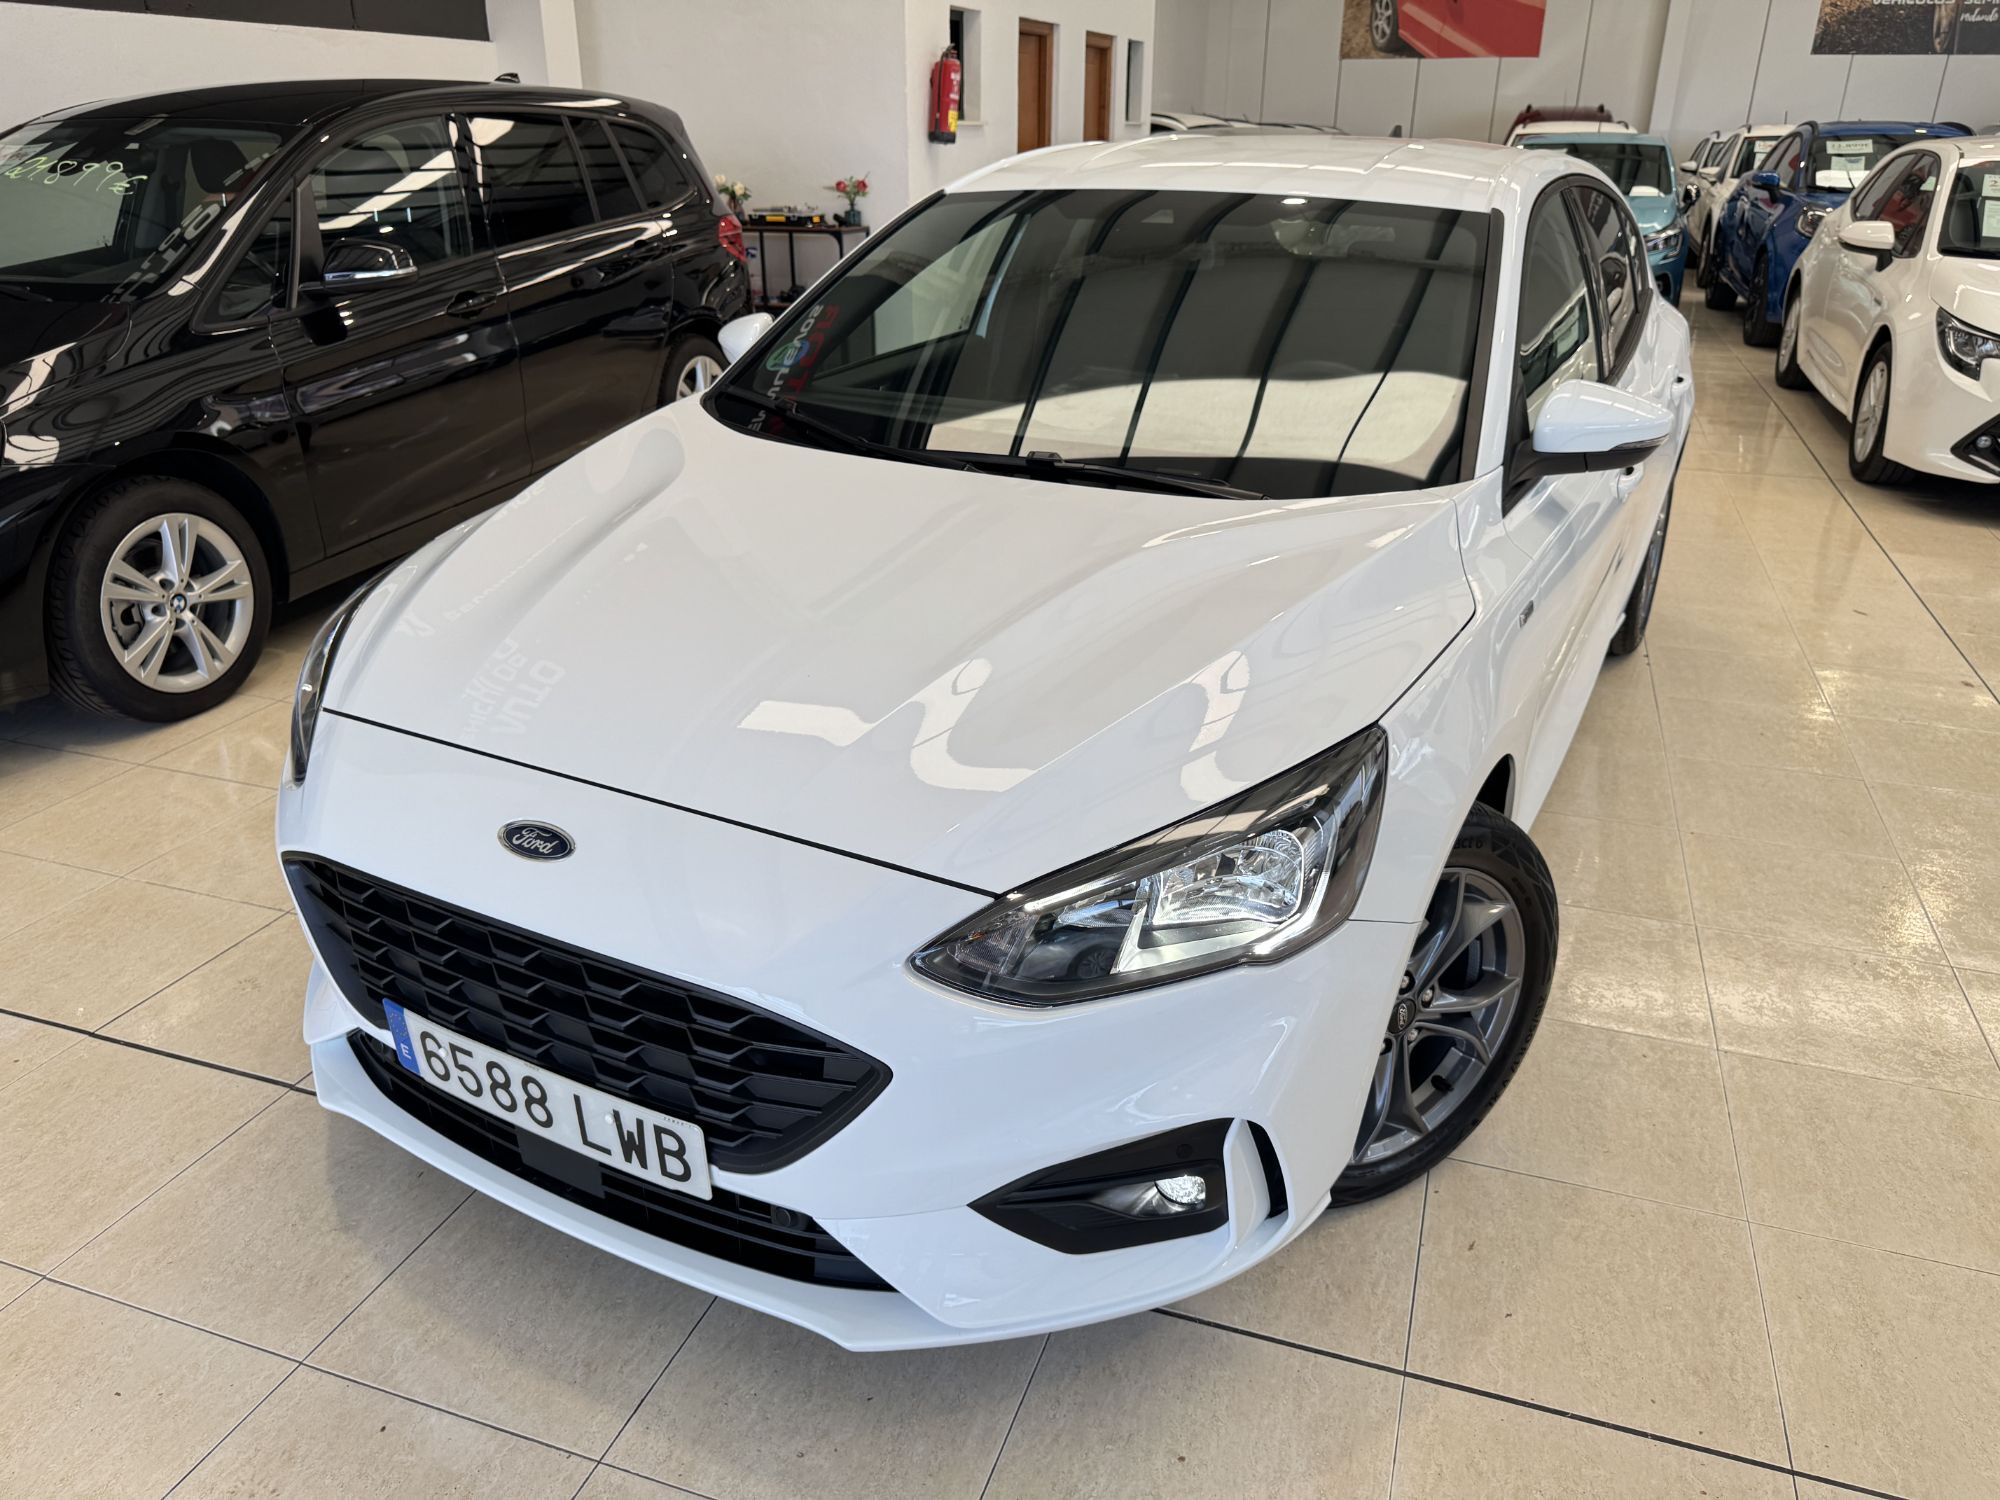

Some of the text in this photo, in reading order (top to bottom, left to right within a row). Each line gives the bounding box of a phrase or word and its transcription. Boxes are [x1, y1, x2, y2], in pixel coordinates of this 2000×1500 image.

[511, 827, 560, 854] Ford
[400, 1042, 412, 1060] E
[419, 1030, 692, 1183] 6588 LWB
